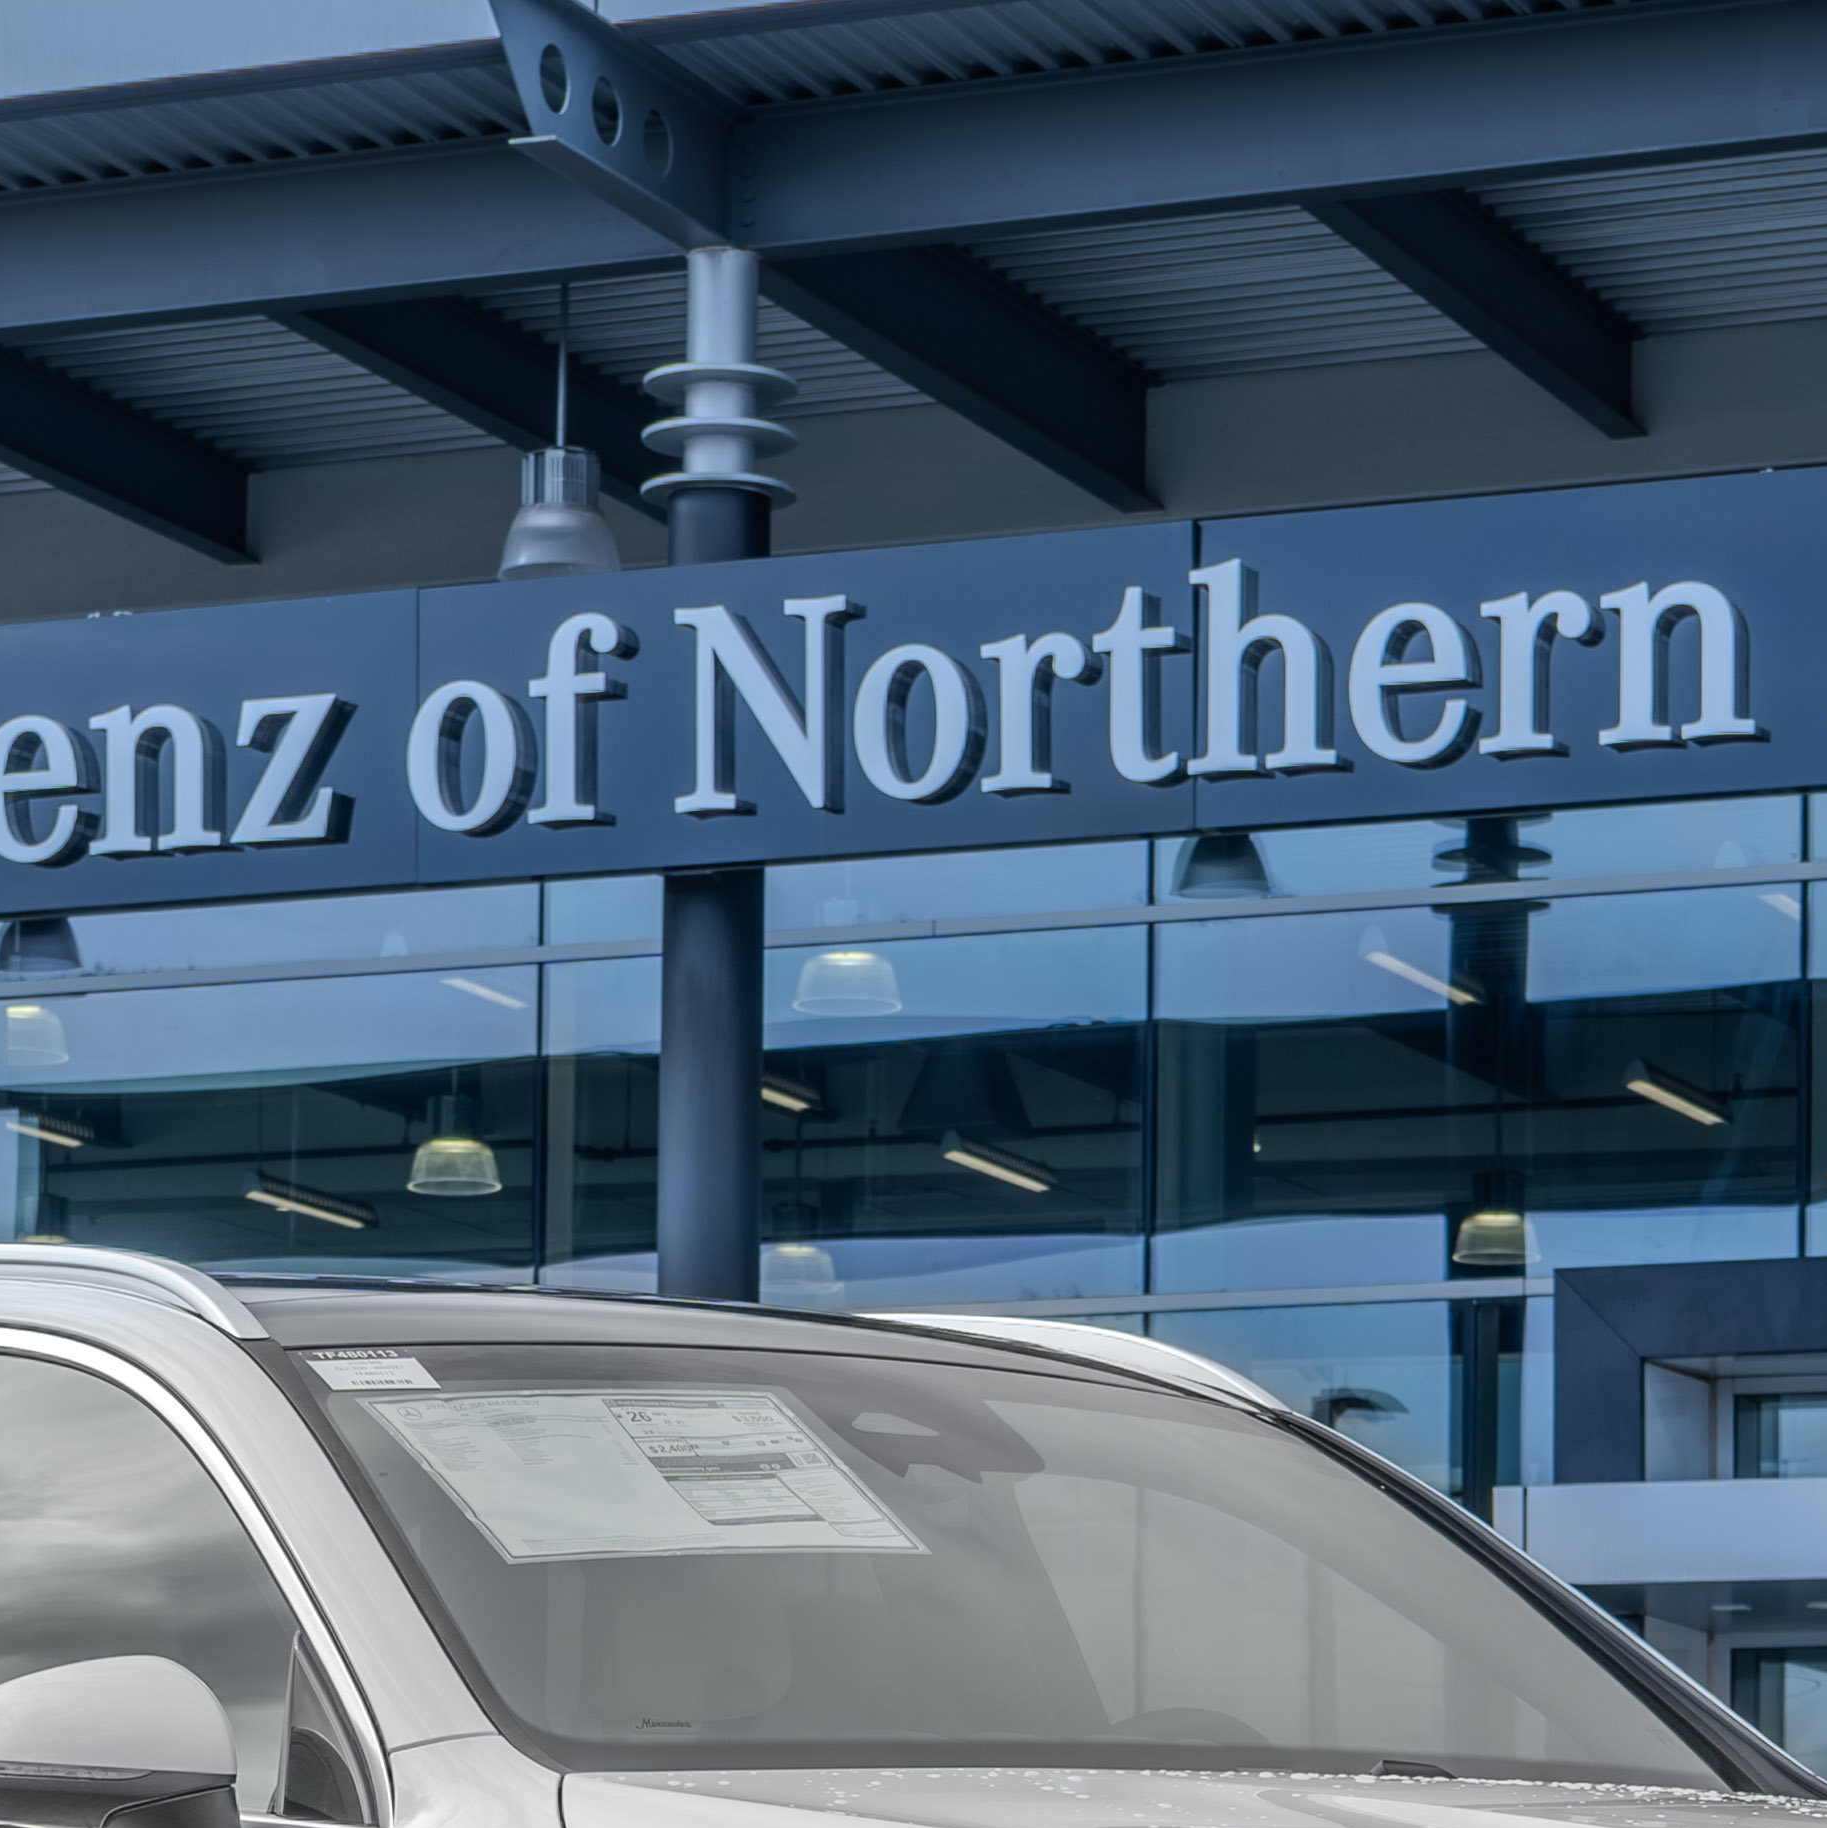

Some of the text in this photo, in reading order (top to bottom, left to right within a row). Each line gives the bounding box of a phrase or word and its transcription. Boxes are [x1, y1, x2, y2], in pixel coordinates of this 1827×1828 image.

[406, 612, 630, 835] of
[673, 558, 1762, 815] Northern
[626, 1411, 652, 1423] 26
